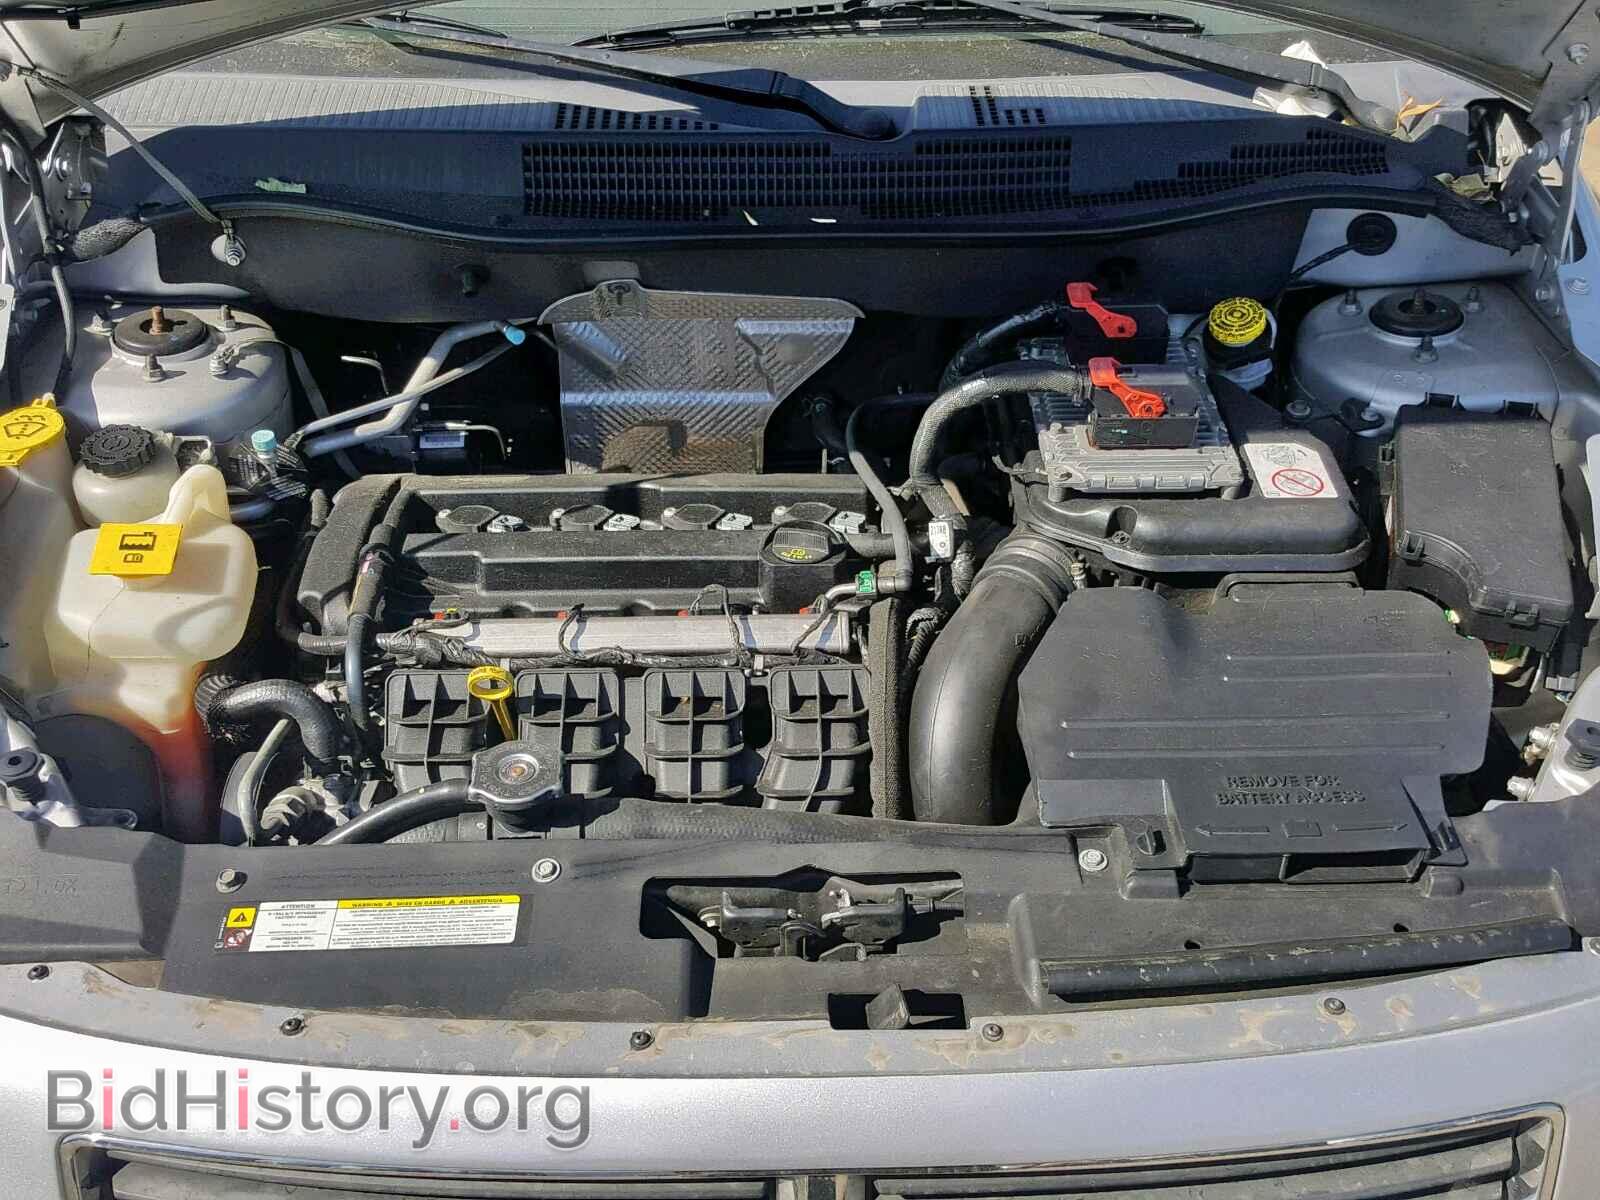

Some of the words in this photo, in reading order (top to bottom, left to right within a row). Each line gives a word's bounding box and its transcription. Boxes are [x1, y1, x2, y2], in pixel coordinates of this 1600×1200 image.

[1227, 776, 1299, 788] REMOVE
[1304, 776, 1342, 787] FOR
[1217, 791, 1291, 806] BATTERY
[1297, 790, 1367, 804] ACCESS
